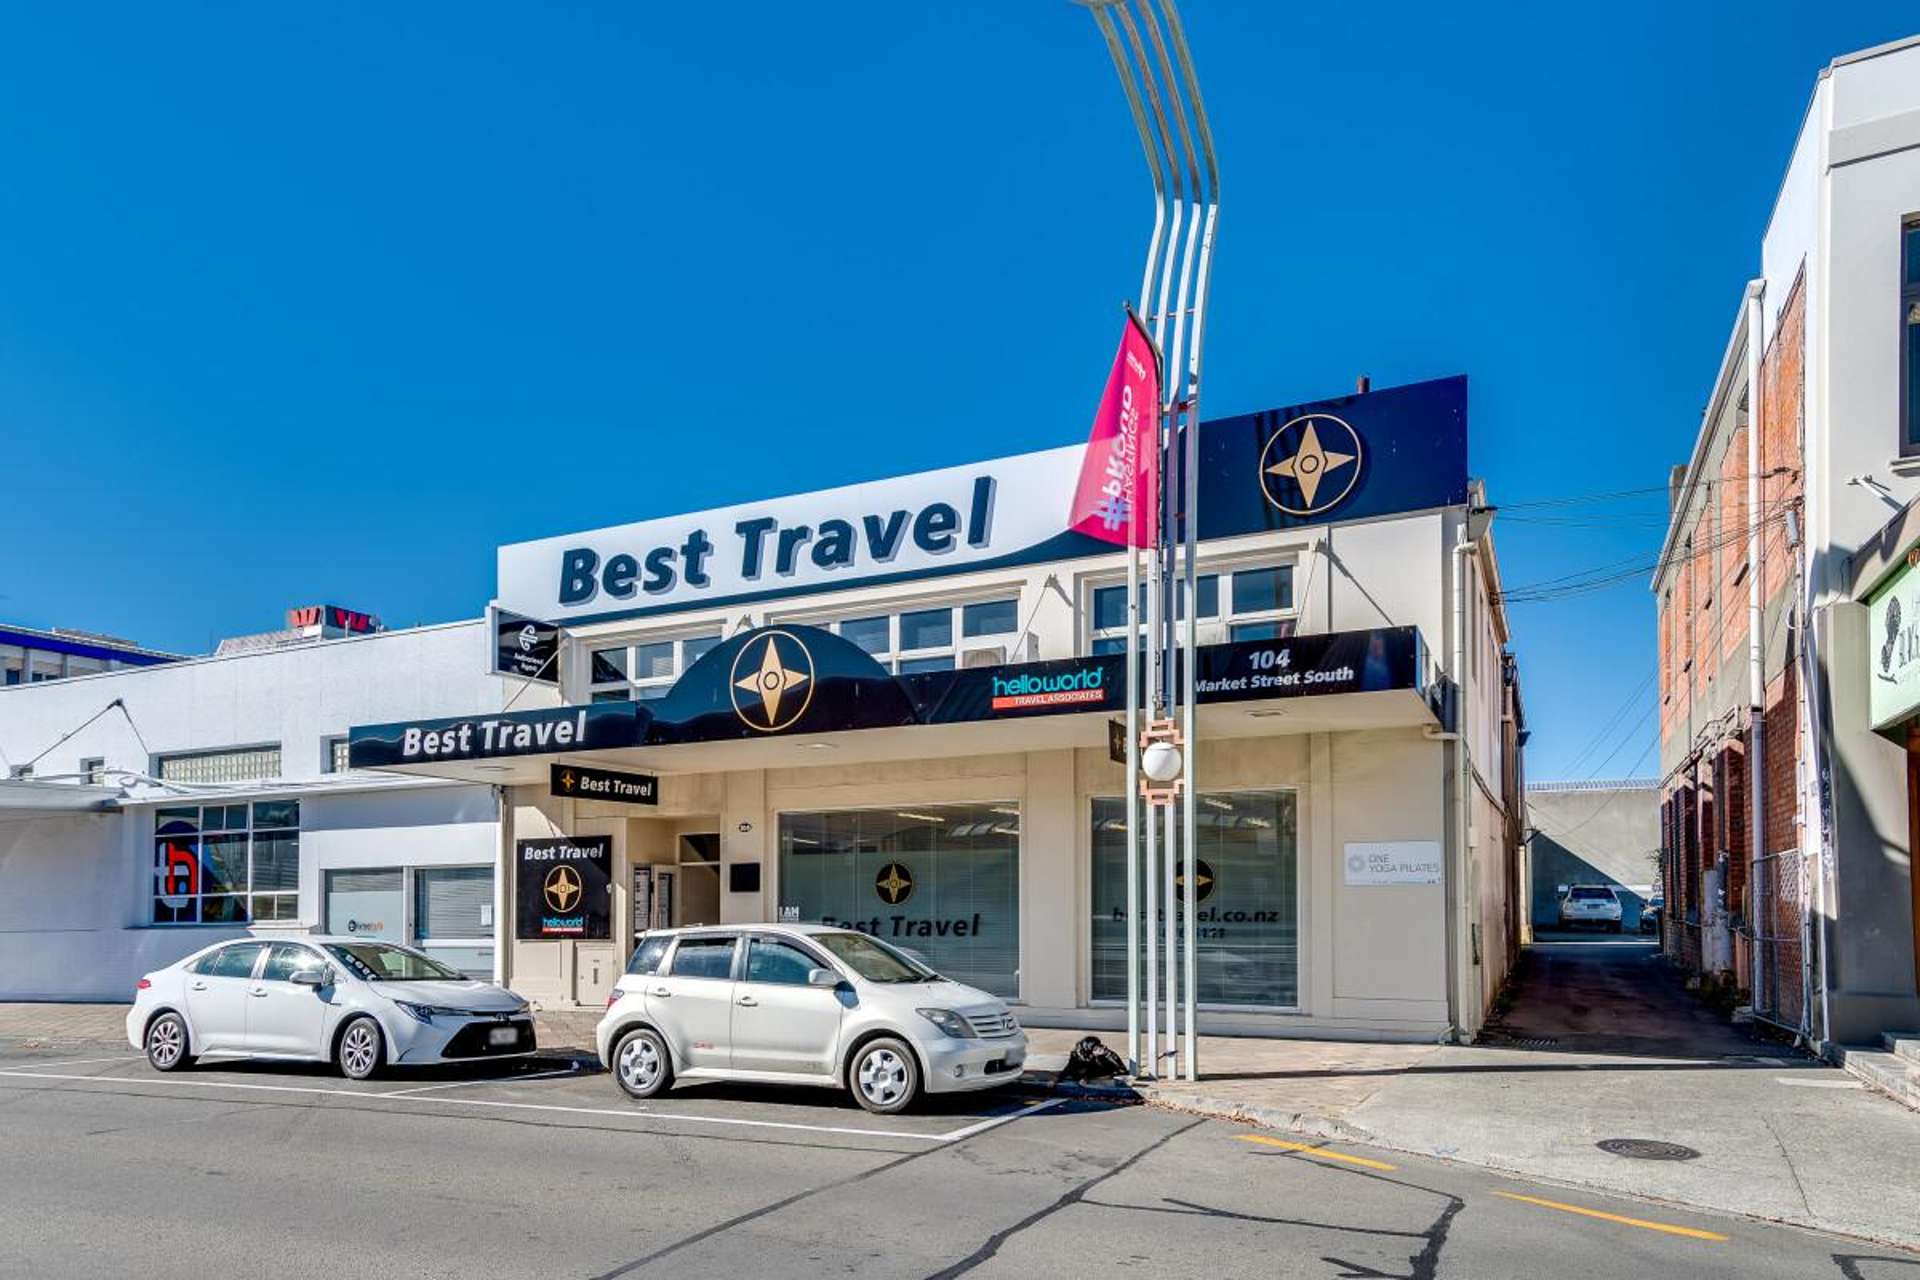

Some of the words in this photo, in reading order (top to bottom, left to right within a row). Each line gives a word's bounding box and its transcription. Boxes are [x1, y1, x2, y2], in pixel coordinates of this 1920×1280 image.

[559, 528, 713, 606] Best
[735, 475, 997, 580] Travel
[1249, 648, 1291, 670] 104
[992, 666, 1104, 696] helloworld
[1195, 676, 1247, 692] Market
[1250, 672, 1301, 688] Street
[1303, 666, 1354, 684] South
[1015, 693, 1047, 705] TRAVEL
[1048, 689, 1104, 703] ASSOCIATES
[403, 723, 472, 756] Best
[481, 710, 587, 750] Travel
[580, 775, 611, 793] Best
[613, 779, 652, 797] Travel
[524, 845, 556, 860] Best
[558, 842, 604, 859] Travel
[1368, 853, 1390, 863] ONE
[1368, 863, 1398, 873] YOGA
[1399, 862, 1441, 873] PILATES
[890, 913, 981, 937] Travel
